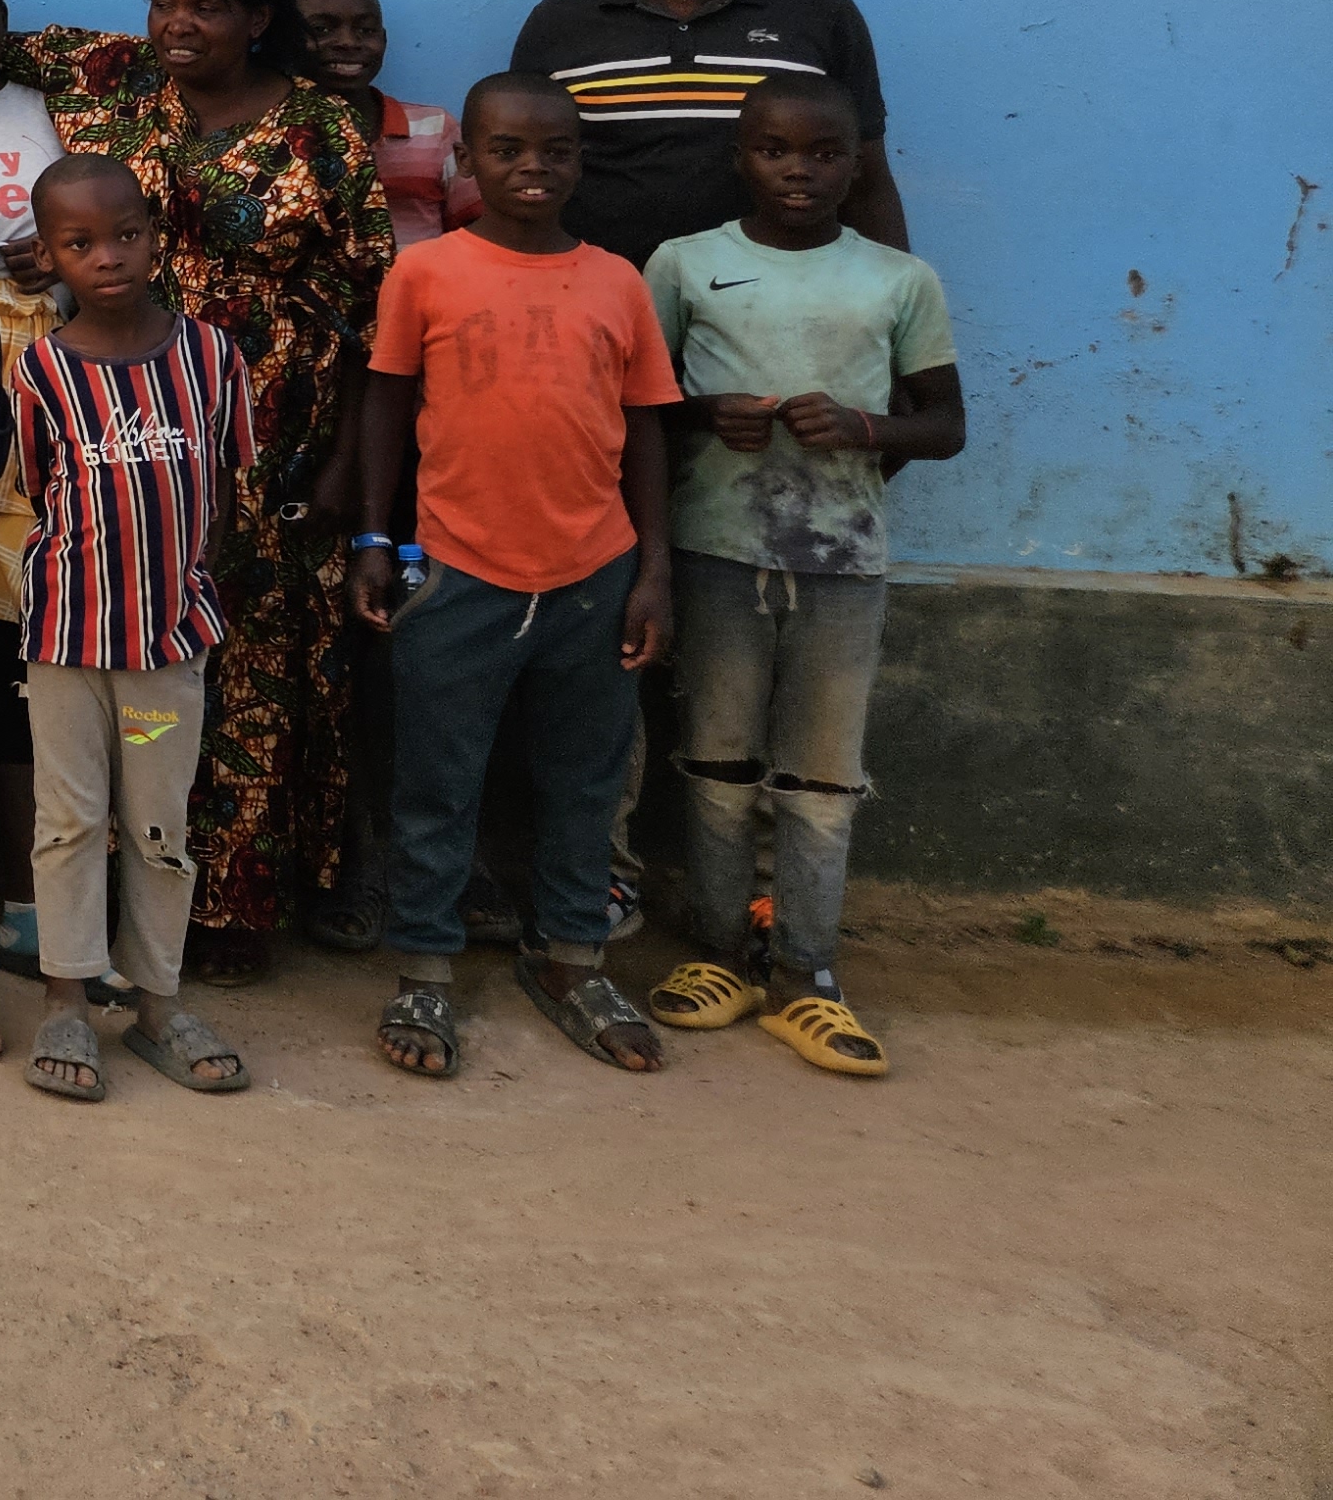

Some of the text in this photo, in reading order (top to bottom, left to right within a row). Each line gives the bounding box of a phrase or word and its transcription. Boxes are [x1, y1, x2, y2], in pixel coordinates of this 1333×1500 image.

[99, 407, 185, 453] Urban
[83, 437, 201, 466] SOCIETY
[122, 705, 180, 723] Reebok
